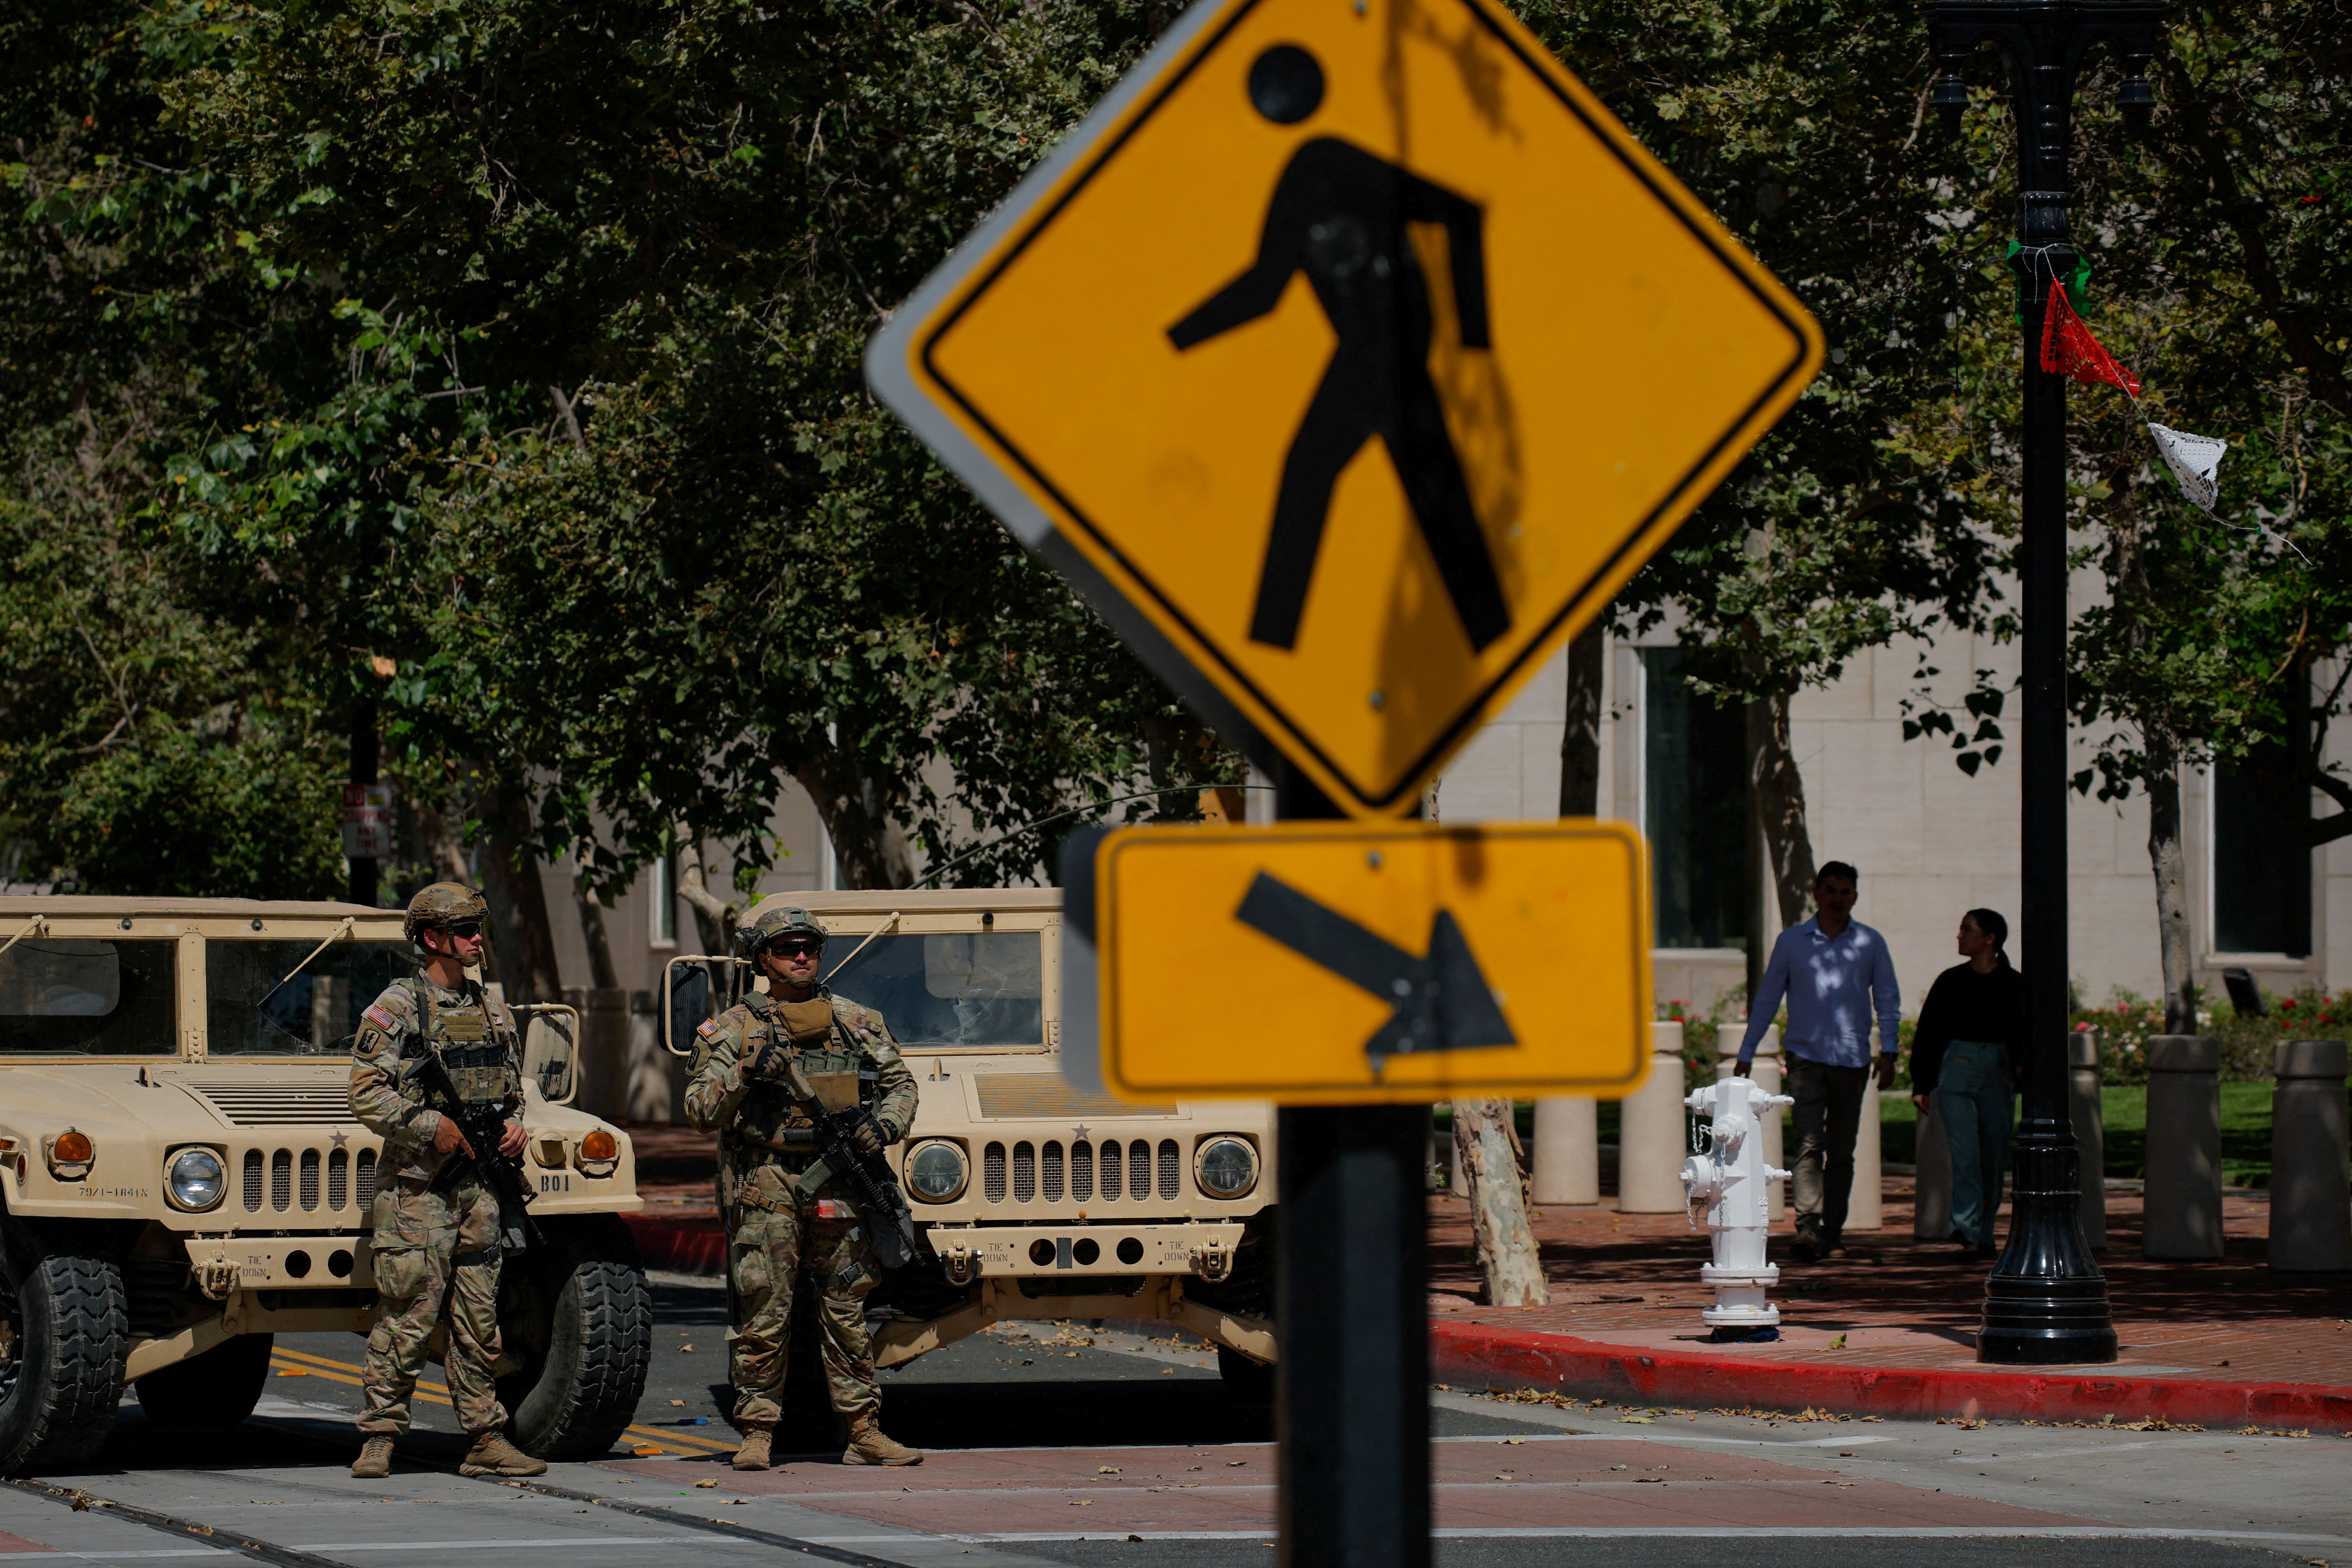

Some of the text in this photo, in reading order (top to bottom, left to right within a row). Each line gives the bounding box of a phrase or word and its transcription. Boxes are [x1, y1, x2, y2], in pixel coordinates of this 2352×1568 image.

[346, 788, 363, 804] NO
[358, 827, 377, 835] ANY
[356, 838, 377, 849] TIME
[989, 1243, 1003, 1251] TIE
[1169, 1241, 1183, 1250] TIE
[248, 1256, 261, 1265] TIE
[984, 1254, 1008, 1262] DOWN
[1165, 1252, 1189, 1261] DOWN
[243, 1268, 266, 1277] DOWN
